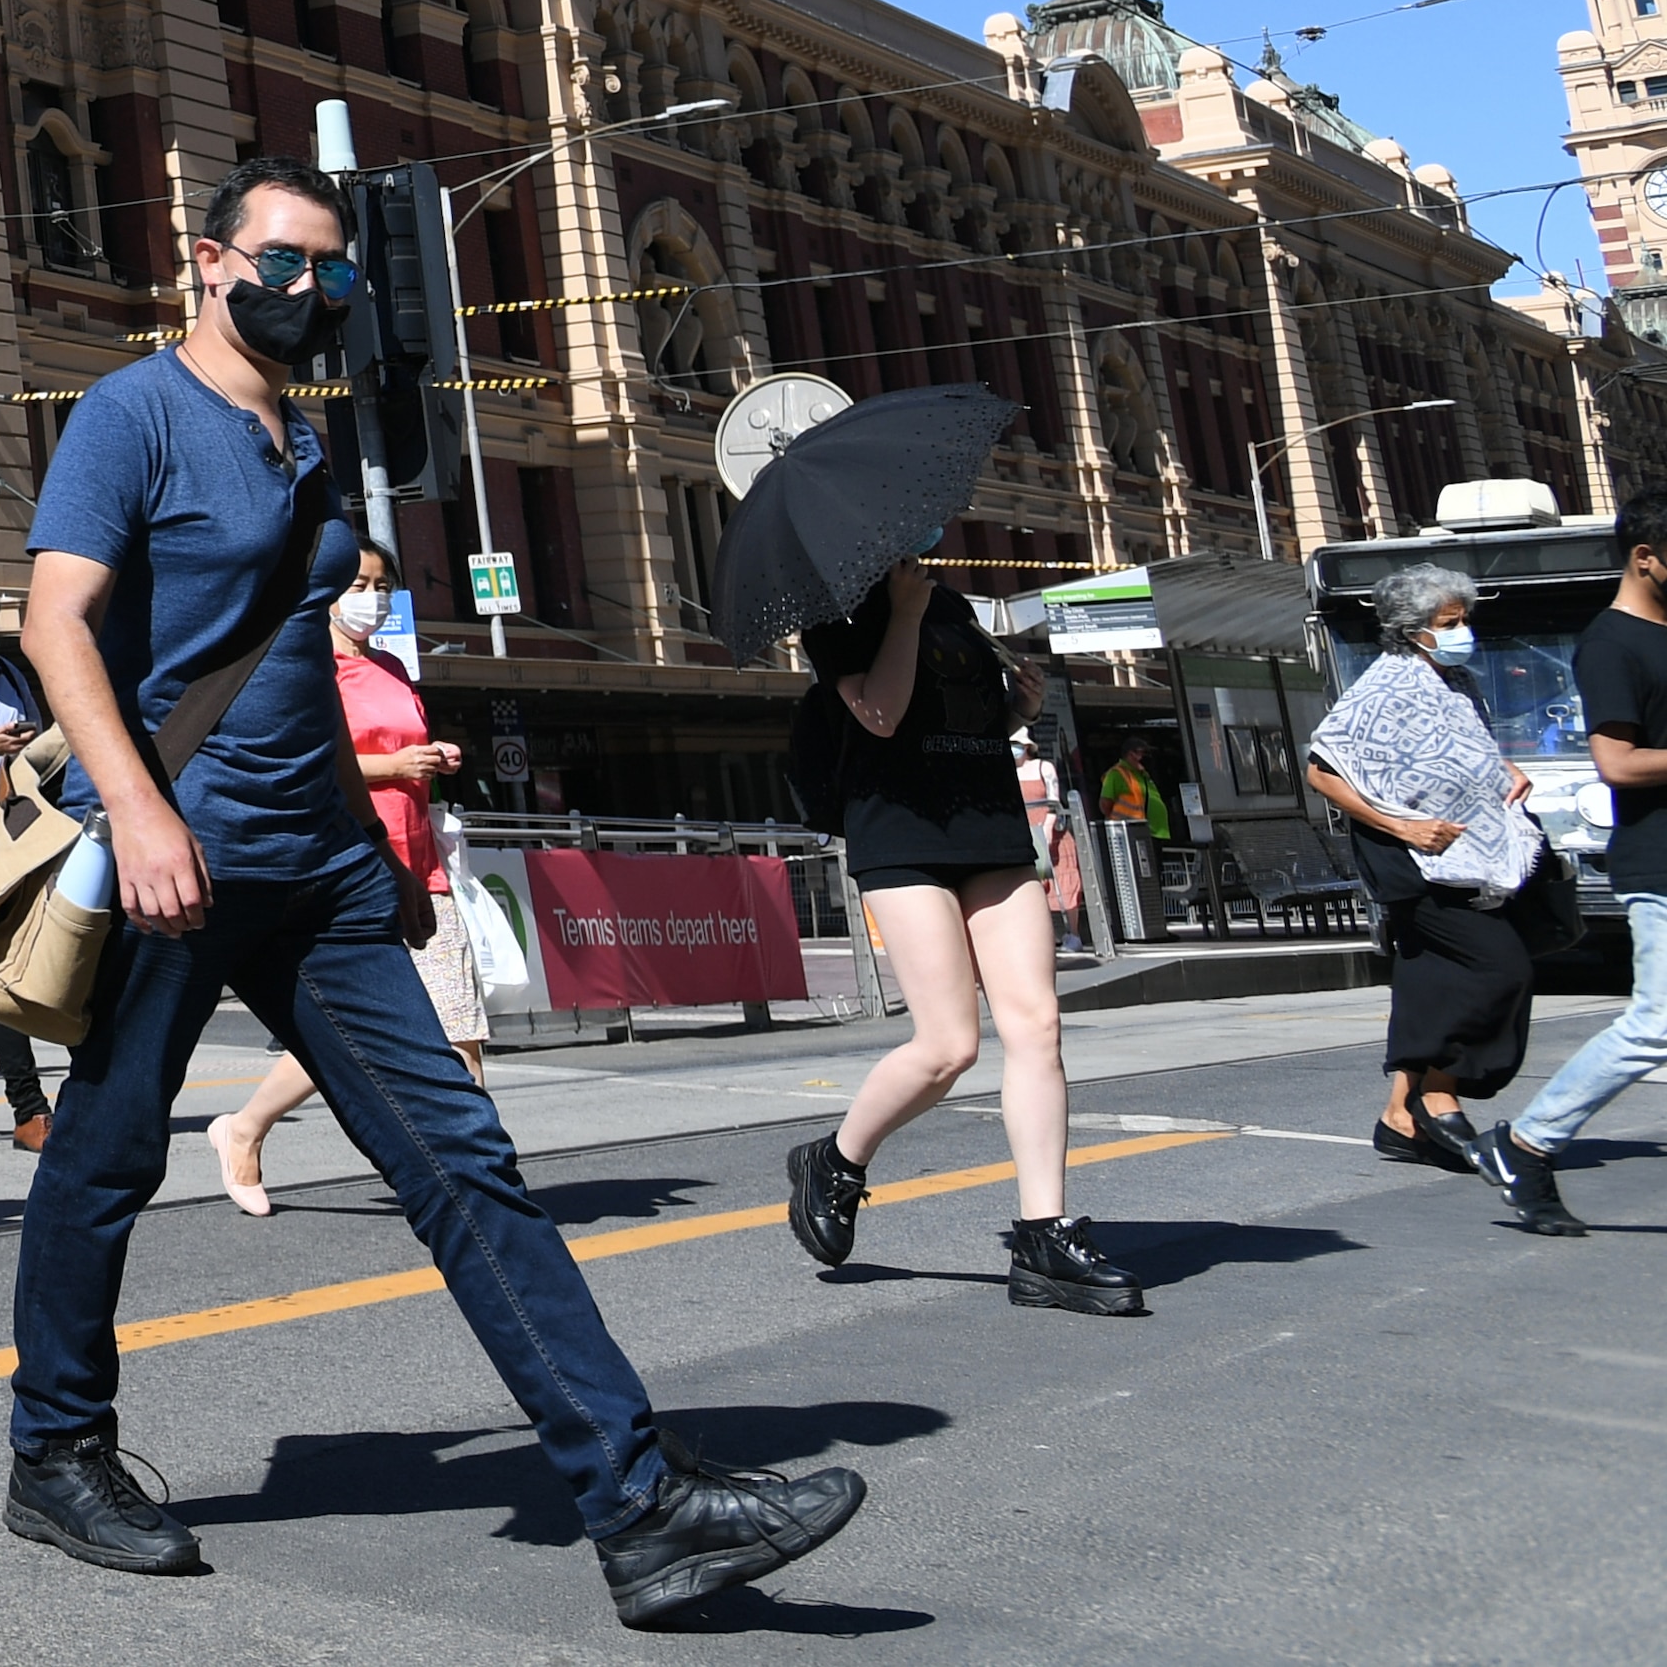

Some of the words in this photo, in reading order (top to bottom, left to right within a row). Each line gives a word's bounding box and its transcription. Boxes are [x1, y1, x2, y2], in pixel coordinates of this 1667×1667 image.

[472, 556, 508, 566] FAIRWAY
[497, 604, 519, 612] TIMES
[499, 750, 523, 767] 40
[553, 908, 616, 946] Tennis
[617, 911, 662, 946] trams
[667, 910, 716, 954] depart
[718, 910, 758, 945] here
